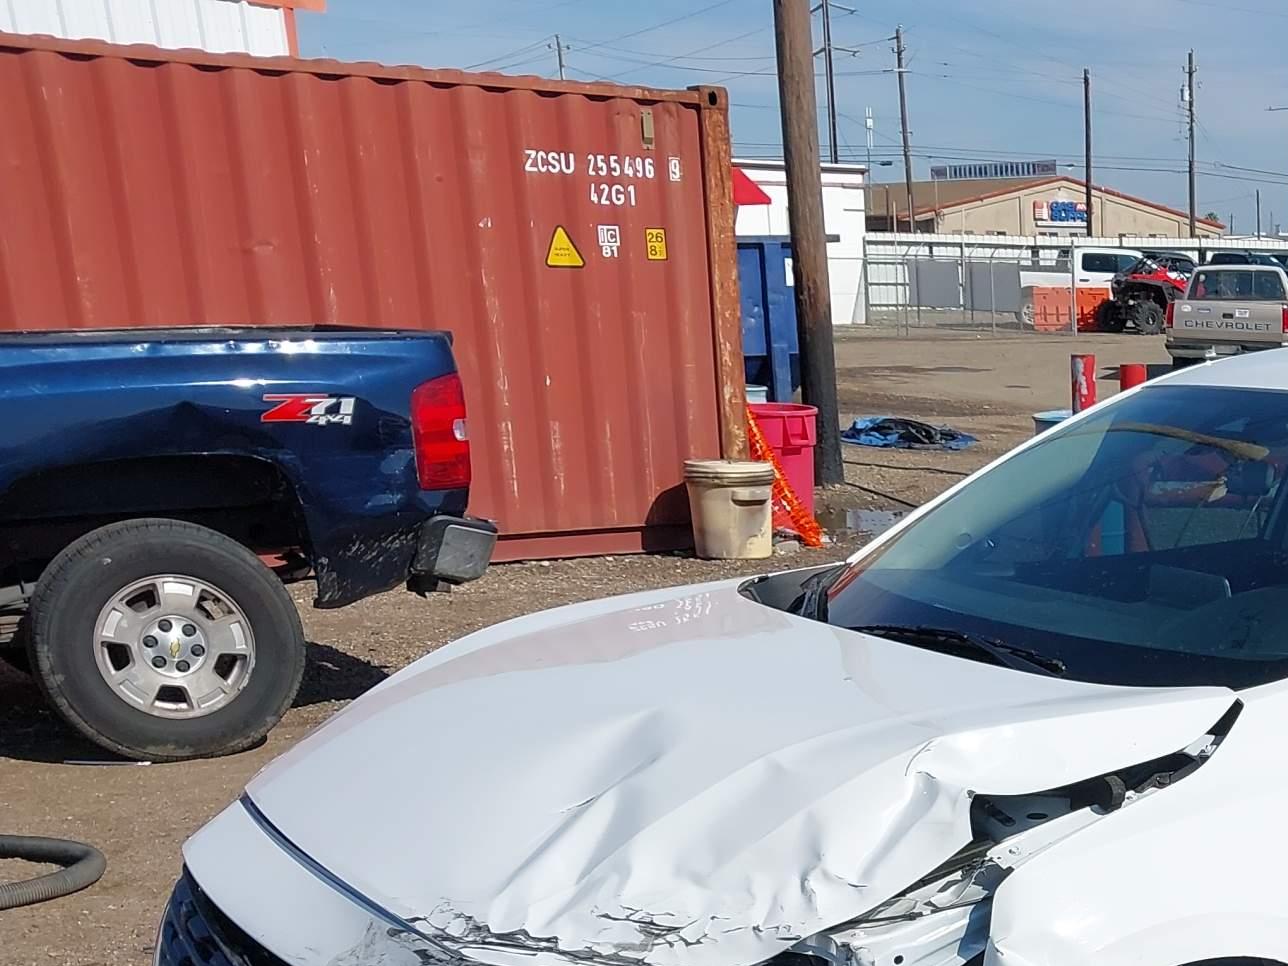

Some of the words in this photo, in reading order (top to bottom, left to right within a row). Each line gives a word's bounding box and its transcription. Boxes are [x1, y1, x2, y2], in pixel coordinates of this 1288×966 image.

[525, 150, 575, 174] ZCSU
[587, 154, 654, 178] 255496
[669, 158, 681, 181] 9
[590, 183, 636, 206] 42G1
[602, 245, 618, 258] 81
[1184, 319, 1272, 331] CHEVROLET
[261, 393, 355, 422] Z71
